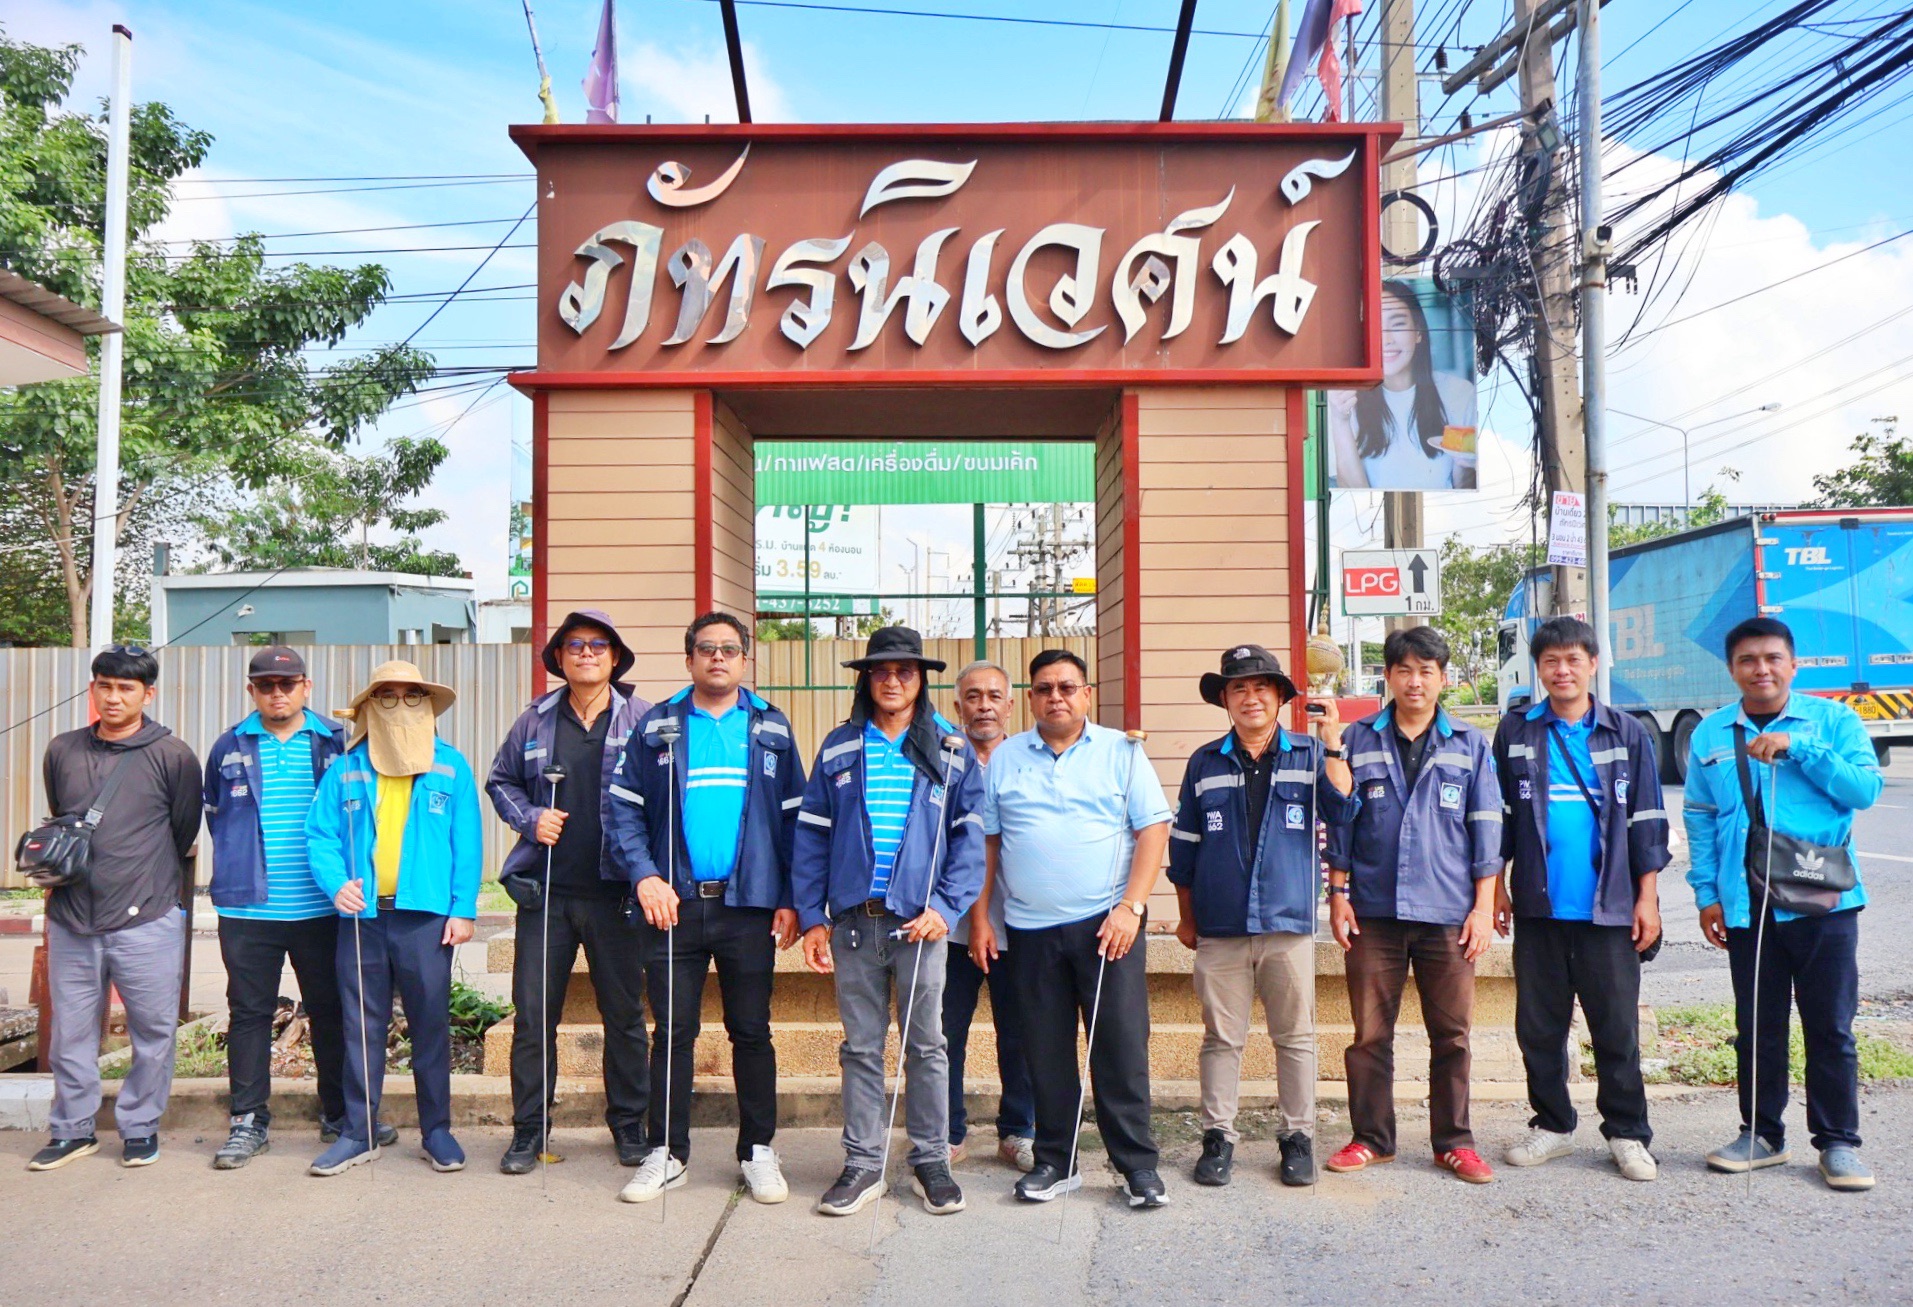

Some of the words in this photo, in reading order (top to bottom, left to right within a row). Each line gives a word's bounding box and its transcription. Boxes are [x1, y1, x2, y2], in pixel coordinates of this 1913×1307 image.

[558, 141, 1357, 352] ภัทรนิเวศน์
[781, 541, 816, 551] บ้านแด
[818, 541, 826, 552] 4
[828, 545, 862, 555] ห้องนอน
[1784, 547, 1832, 565] TBL
[776, 559, 822, 579] 3.59
[1345, 572, 1398, 593] LPG
[1405, 595, 1412, 611] 1
[1415, 600, 1435, 611] กม.
[1793, 869, 1825, 880] adidas
